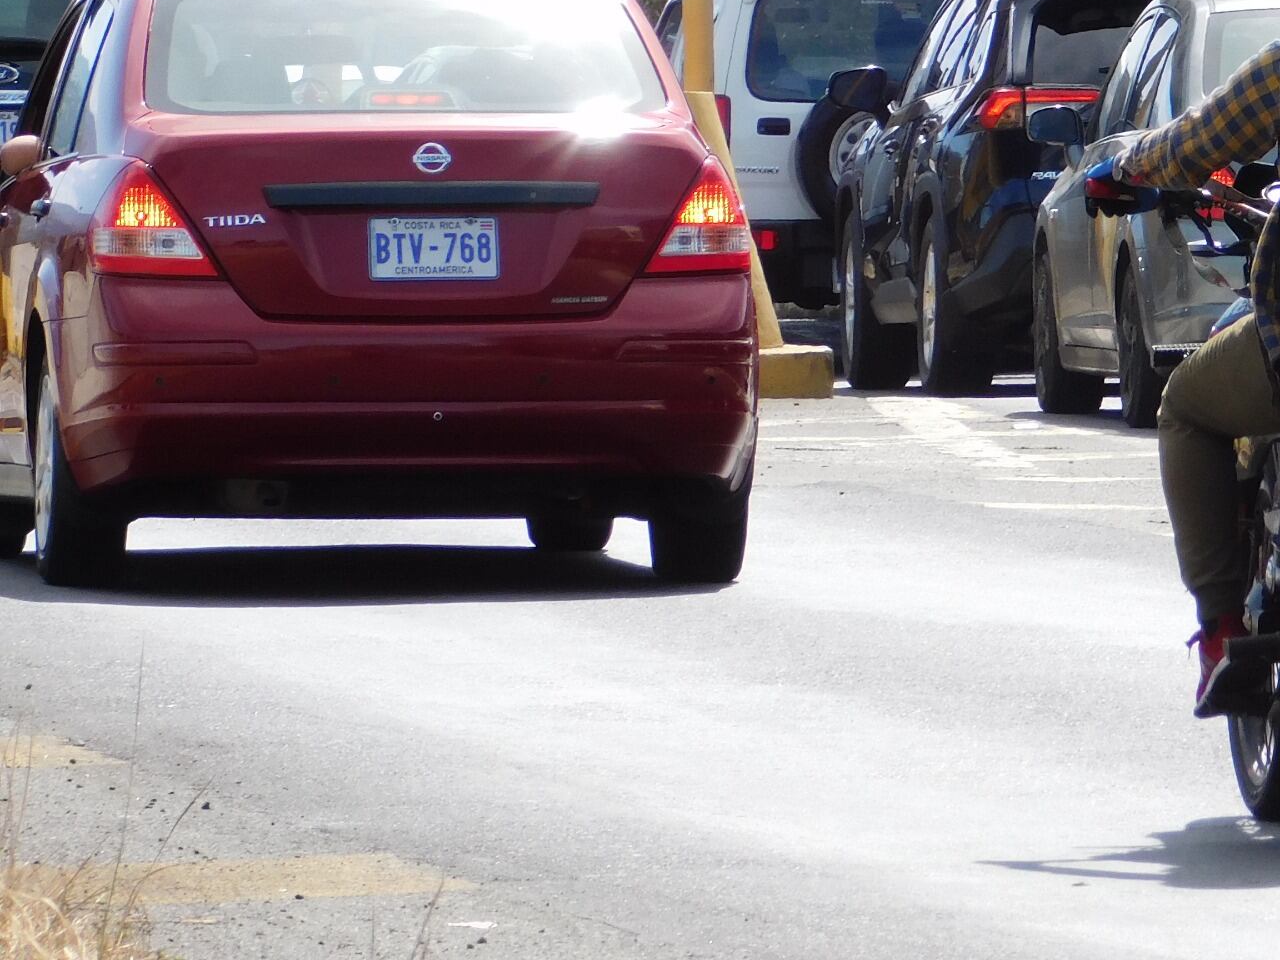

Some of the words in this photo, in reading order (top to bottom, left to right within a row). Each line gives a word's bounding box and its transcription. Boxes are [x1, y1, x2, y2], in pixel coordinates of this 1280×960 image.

[1031, 171, 1064, 180] RAV
[202, 213, 267, 227] TIIDA
[404, 221, 435, 230] COSTA
[439, 221, 461, 229] RICA
[375, 232, 491, 264] BTV-768
[394, 266, 474, 275] CENTROAMERICA
